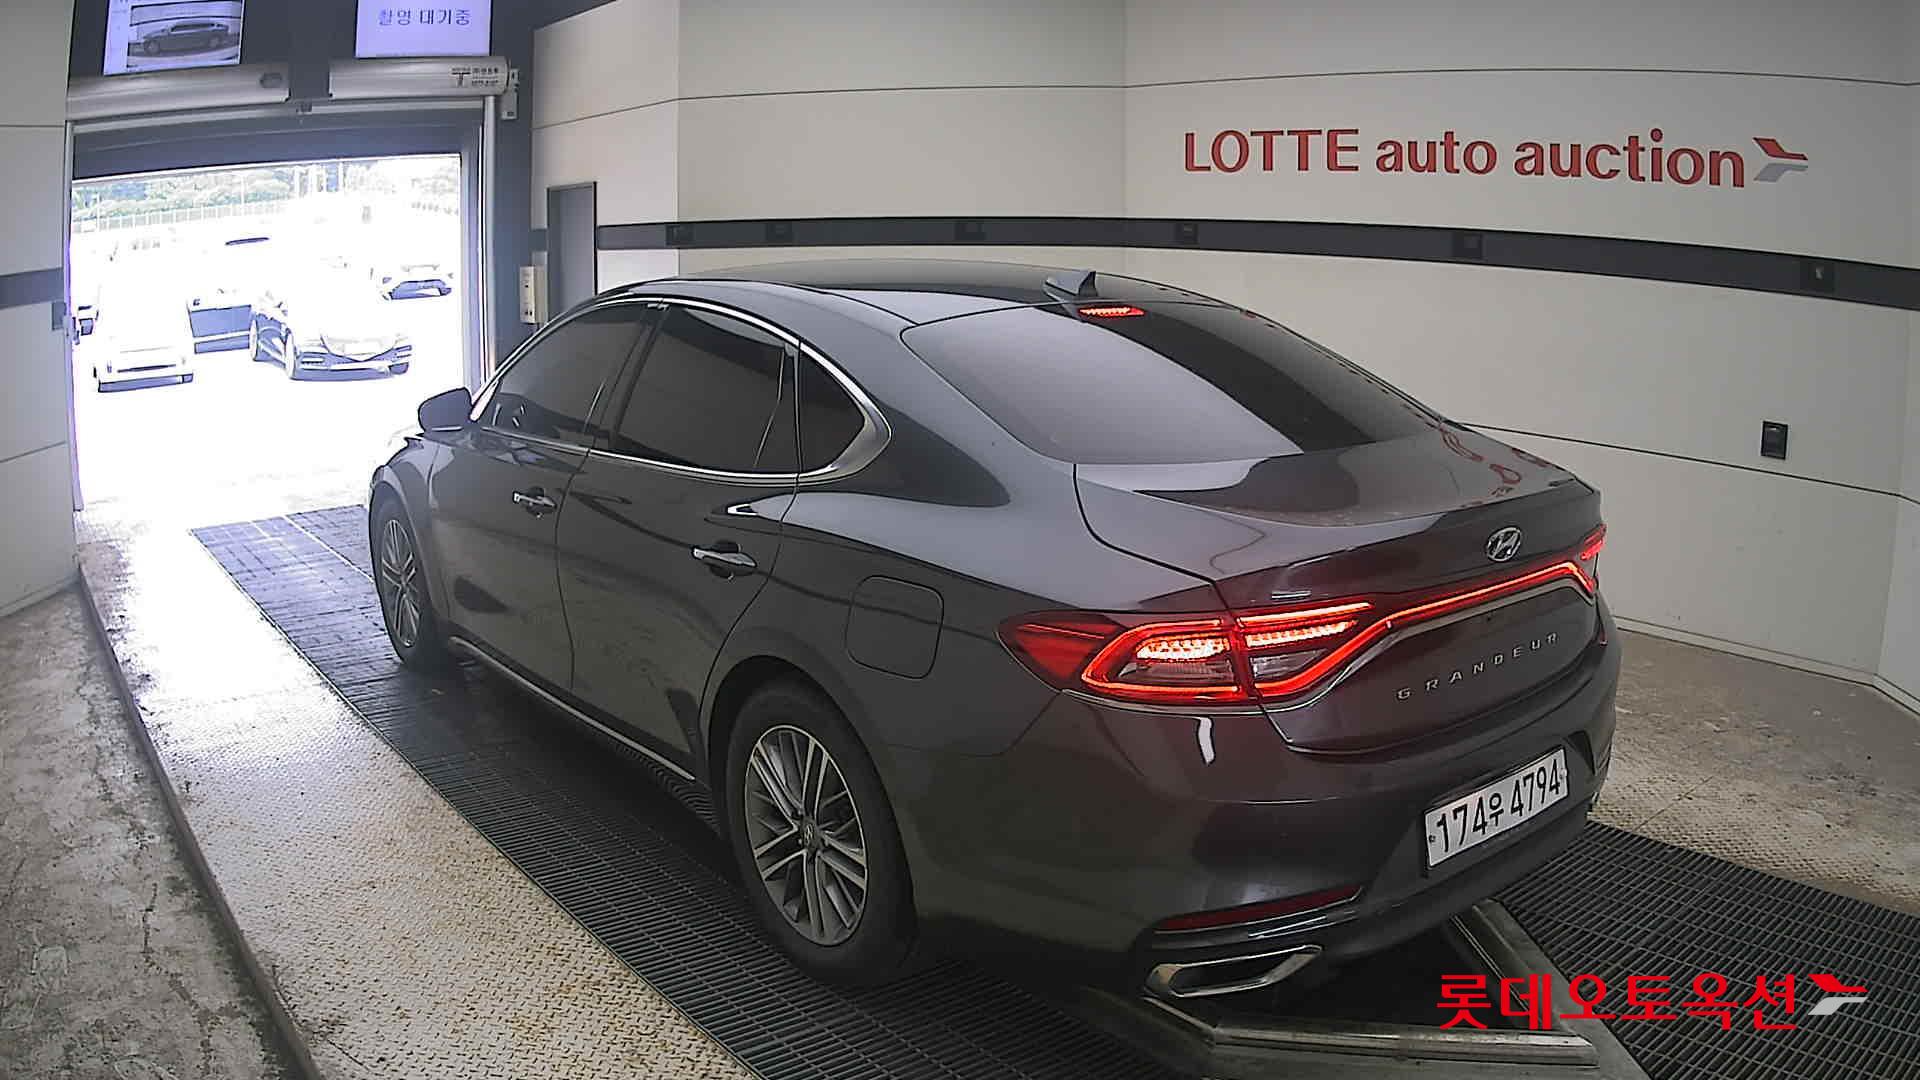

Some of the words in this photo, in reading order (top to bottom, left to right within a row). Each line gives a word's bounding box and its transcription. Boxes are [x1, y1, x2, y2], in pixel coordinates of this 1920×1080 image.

[419, 8, 471, 26] 대기중
[1184, 128, 1360, 174] LOTTE
[1375, 130, 1498, 175] auto
[1513, 127, 1745, 188] auction
[1396, 631, 1558, 701] GRANDEUR
